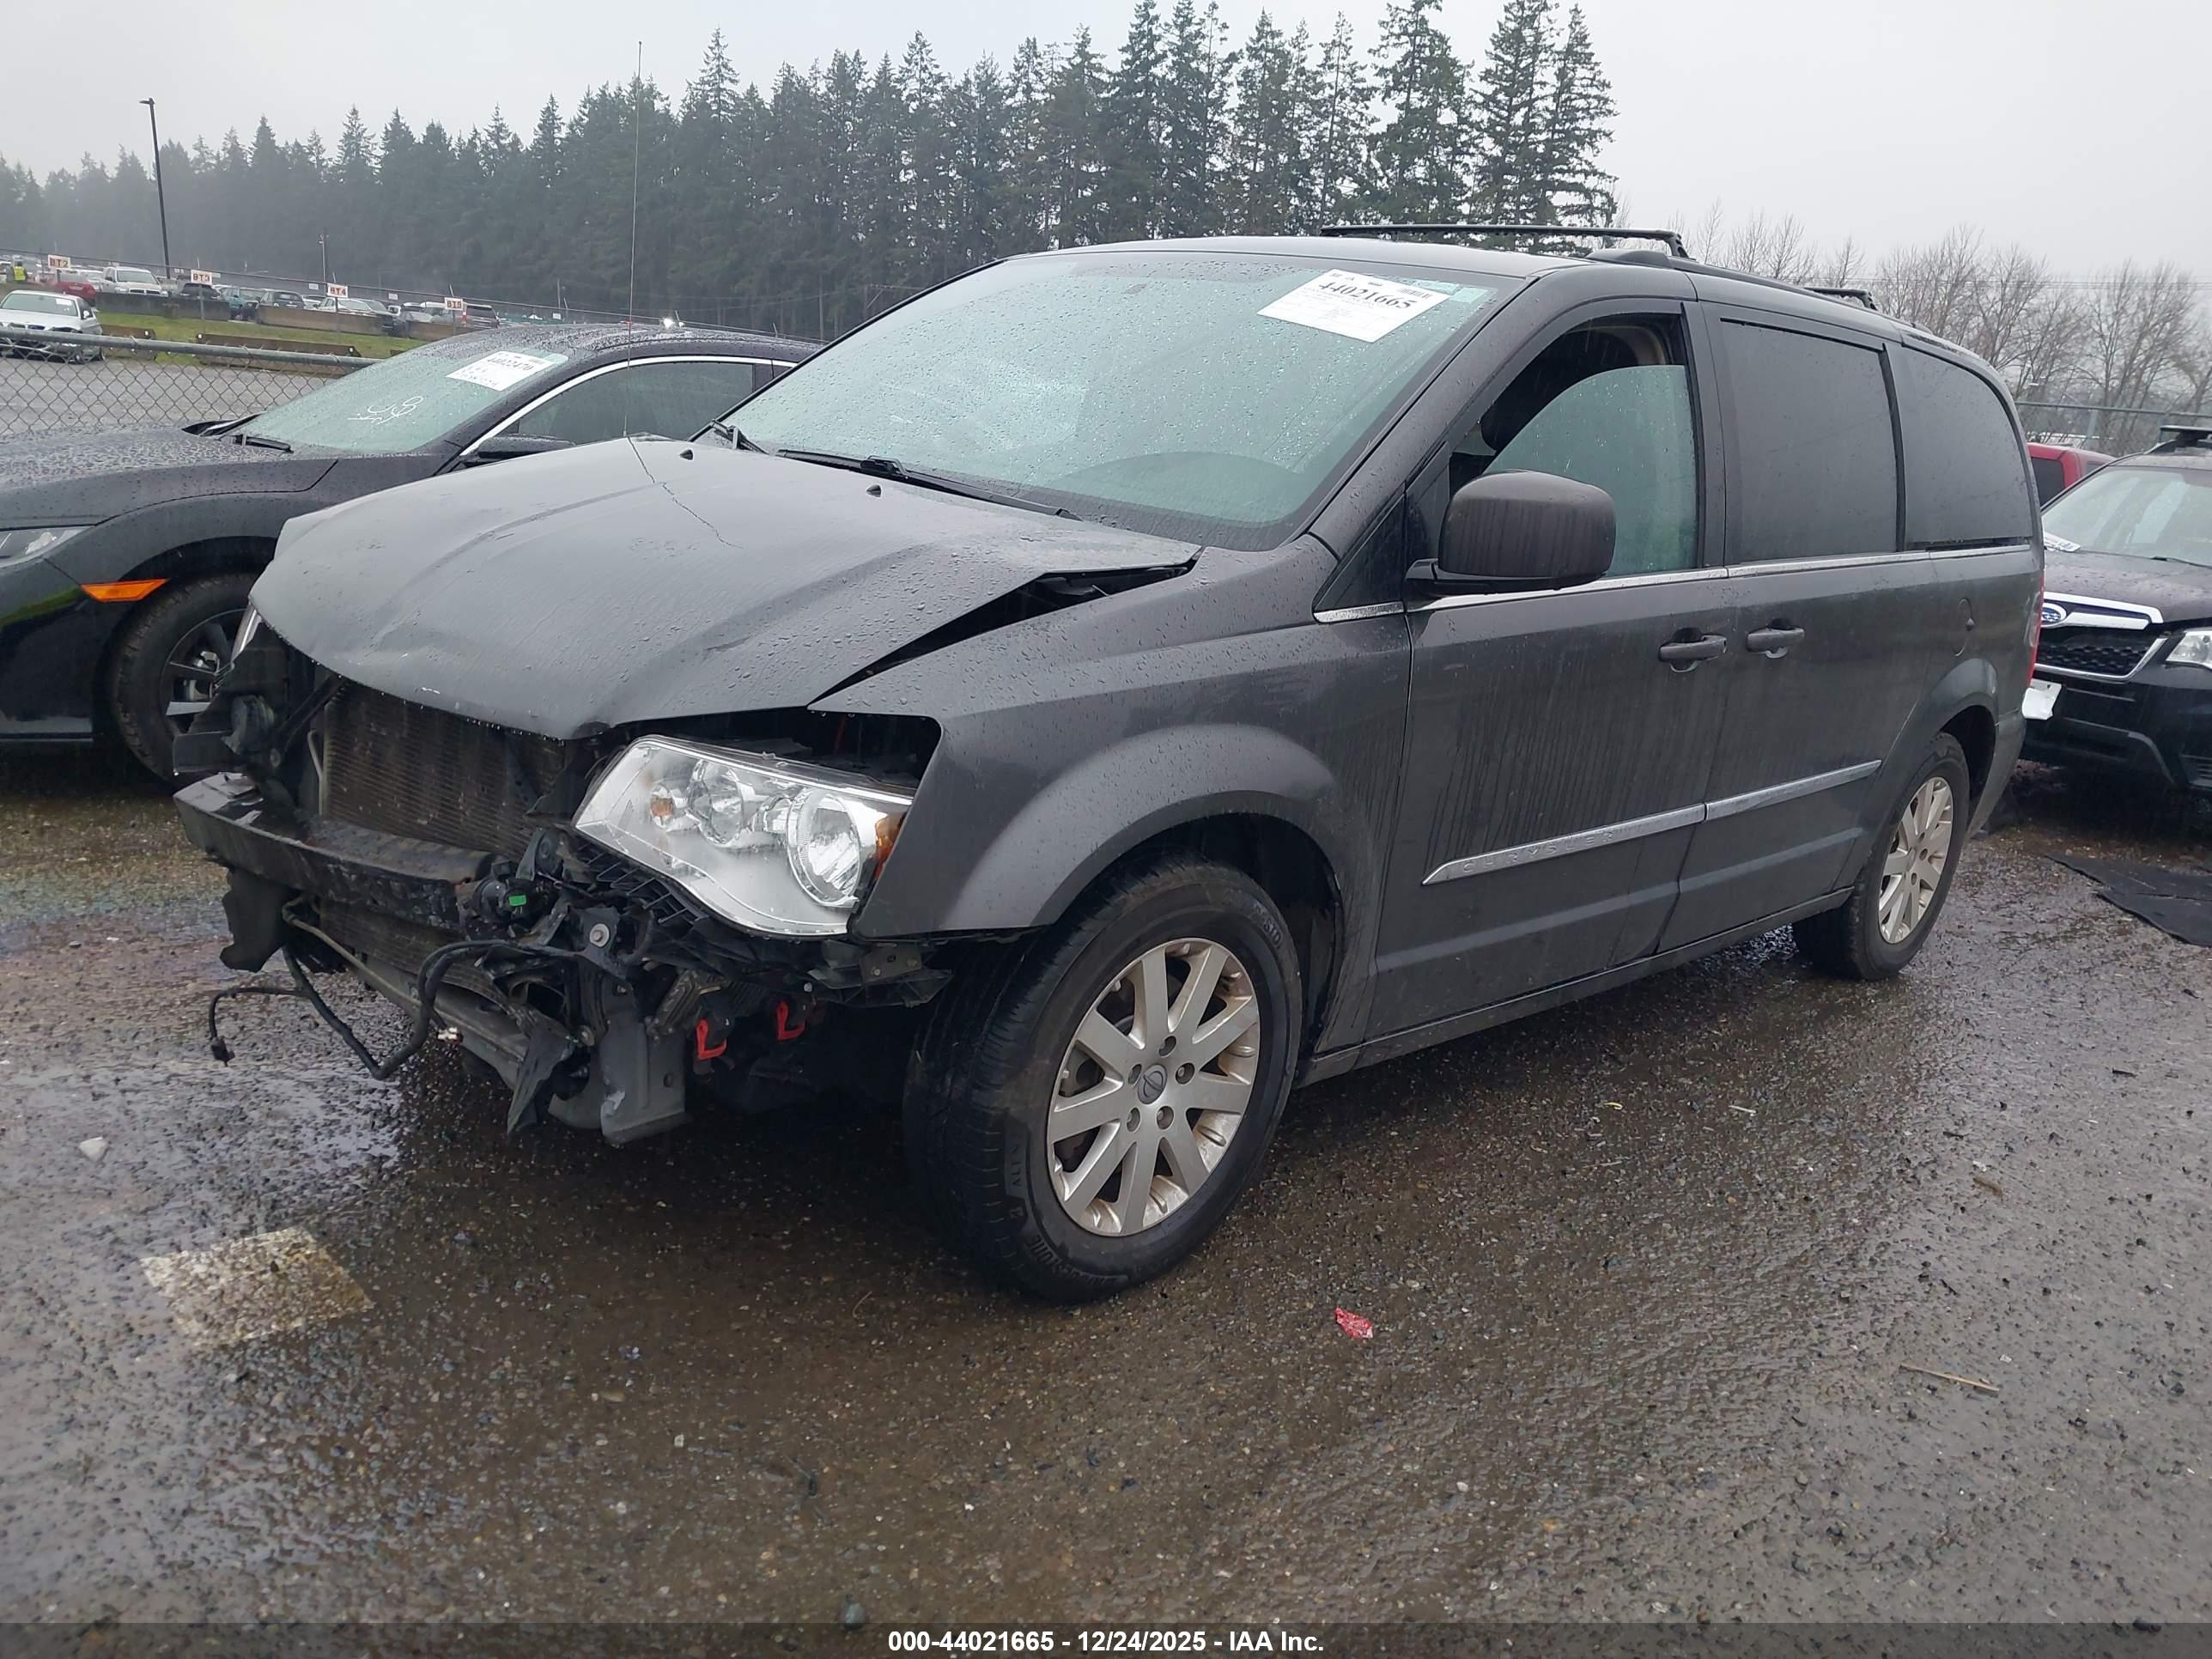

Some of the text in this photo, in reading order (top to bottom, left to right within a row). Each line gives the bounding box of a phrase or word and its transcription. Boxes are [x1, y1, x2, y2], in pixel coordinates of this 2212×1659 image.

[50, 258, 69, 267] BT2
[192, 273, 210, 282] BT3
[330, 287, 346, 296] BT4
[1318, 282, 1418, 309] 44021665
